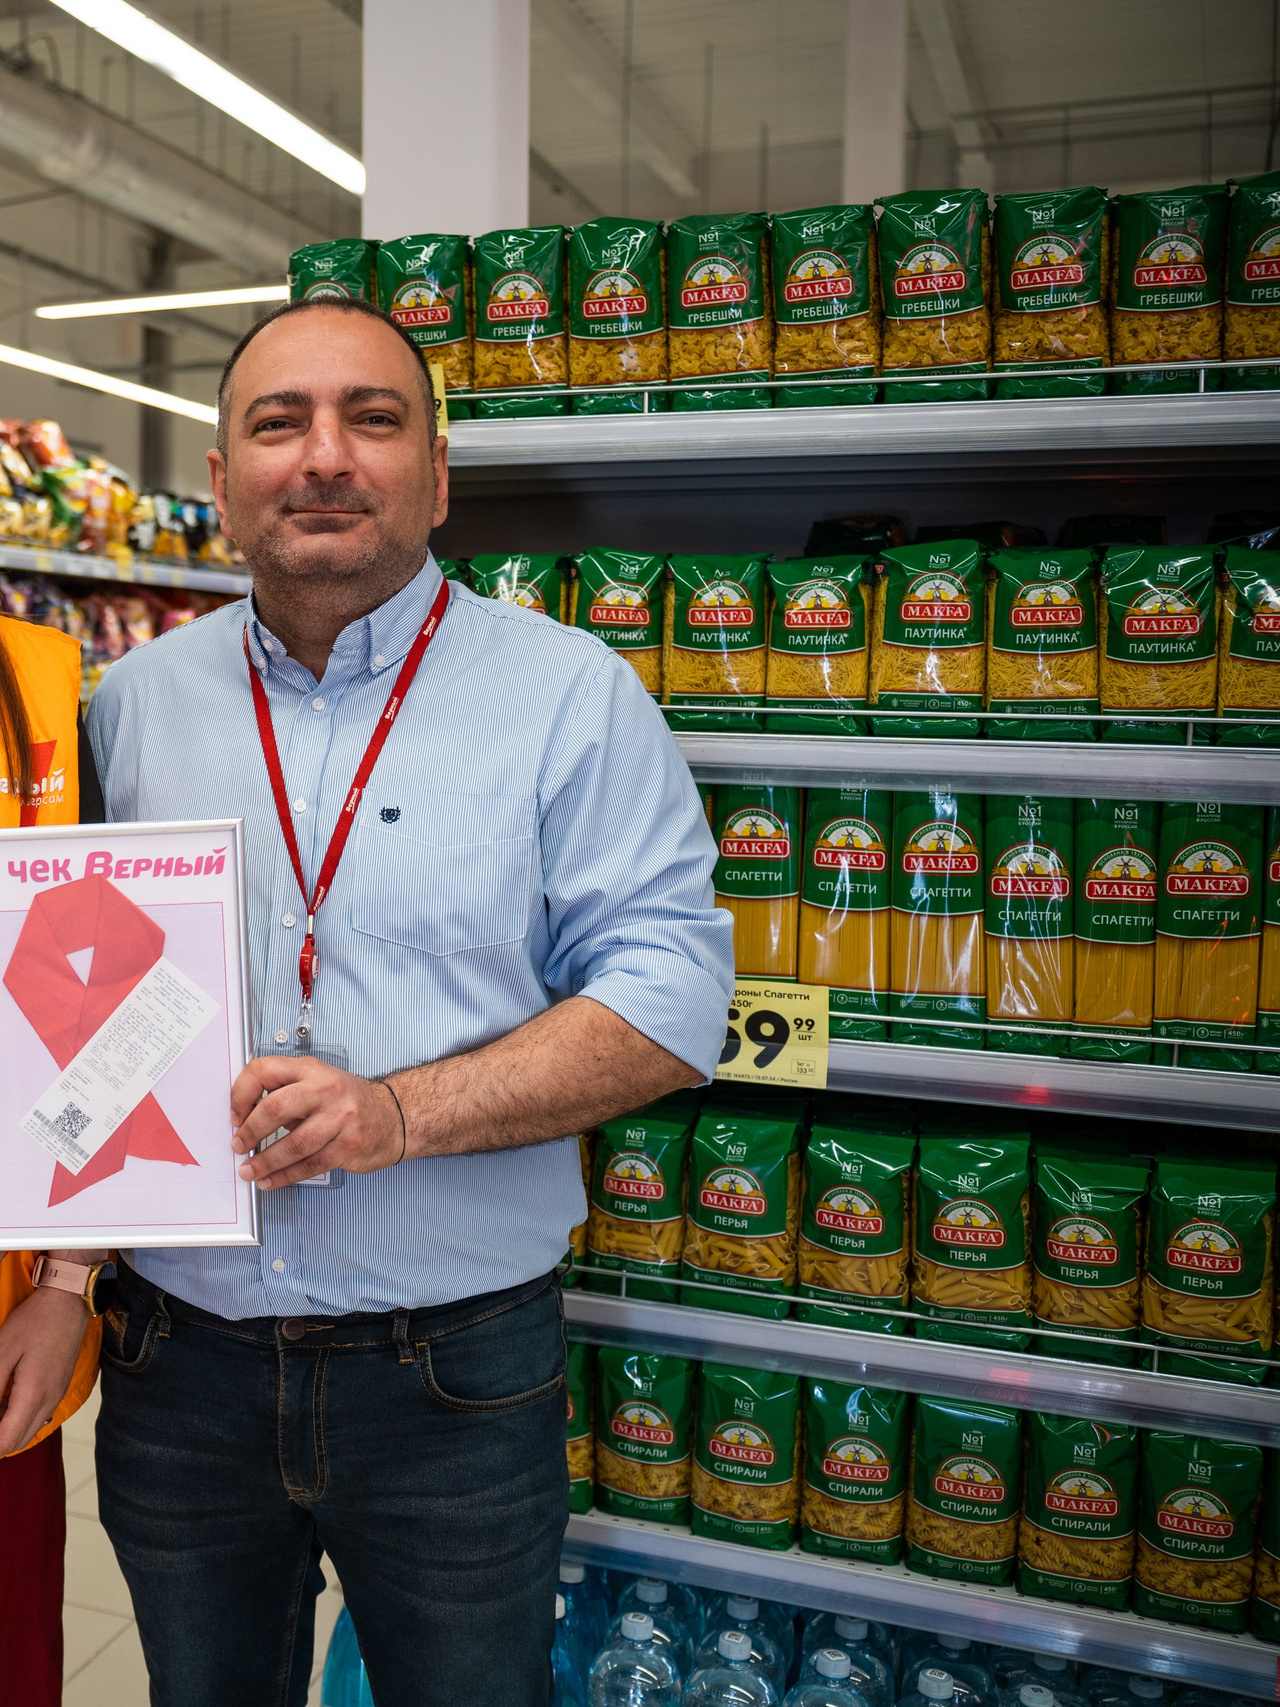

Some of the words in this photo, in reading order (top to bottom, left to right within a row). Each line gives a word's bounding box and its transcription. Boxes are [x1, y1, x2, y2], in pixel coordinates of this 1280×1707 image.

[1016, 270, 1076, 285] MAKFA
[1140, 268, 1202, 283] MAKFA
[790, 283, 845, 298] MAKFA
[900, 276, 958, 292] MAKFA
[687, 286, 740, 301] MAKFA
[1018, 292, 1078, 308] ГРЕБЕШКИ
[1140, 291, 1203, 306] ГРЕБЕШКИ
[492, 304, 542, 316] MAKFA
[588, 300, 640, 314] MAKFA
[792, 304, 848, 318] ГРЕБЕШКИ
[902, 298, 960, 314] ГРЕБЕШКИ
[396, 309, 445, 323] MAKFA
[688, 308, 742, 324] ГРЕБЕШКИ
[493, 325, 544, 338] ГРЕБЕШКИ
[590, 321, 642, 334] ГРЕБЕШКИ
[410, 330, 447, 341] БЕШКИ
[596, 608, 644, 621] MAKFA
[694, 610, 748, 622] MAKFA
[908, 604, 965, 617] MAKFA
[1018, 610, 1077, 622] MAKFA
[790, 614, 844, 624] MAKFA
[1132, 618, 1194, 632] MAKFA
[593, 630, 646, 642] ПАУТИНКА
[692, 631, 747, 642] ПАУТИНКА
[788, 635, 846, 646] ПАУТИНКА
[904, 628, 964, 639] ПАУТИНКА
[1016, 632, 1078, 644] ПАУТИНКА
[1129, 642, 1194, 654] ПАУТИНКА
[346, 788, 358, 812] Верный
[1115, 808, 1138, 819] №1
[1196, 802, 1221, 814] №1
[726, 842, 784, 855] MAKFA
[820, 850, 878, 867] MAKFA
[909, 856, 972, 870] MAKFA
[8, 858, 72, 883] чек
[725, 871, 782, 882] СПАГЕТТИ
[818, 880, 877, 894] СПАГЕТТИ
[910, 886, 972, 898] СПАГЕТТИ
[998, 880, 1062, 892] MAKFA
[1093, 884, 1156, 897] MAKFA
[1174, 878, 1240, 892] MAKFA
[314, 886, 324, 912] ерный
[998, 910, 1062, 922] СПАГЕТТИ
[1092, 914, 1154, 926] СПАГЕТТИ
[1173, 909, 1240, 921] СПАГЕТТИ
[764, 990, 810, 1000] Спагетти
[794, 1018, 815, 1031] 99
[607, 1178, 658, 1196] MAKFA
[614, 1200, 647, 1214] ПЕРЬЯ
[706, 1194, 760, 1212] MAKFA
[714, 1216, 748, 1229] ПЕРЬЯ
[820, 1213, 876, 1231] MAKFA
[830, 1235, 865, 1249] ПЕРЬЯ
[940, 1228, 998, 1244] MAKFA
[950, 1250, 986, 1262] ПЕРЬЯ
[1052, 1244, 1111, 1262] MAKFA
[1172, 1252, 1234, 1270] MAKFA
[1060, 1266, 1099, 1280] ПЕРЬЯ
[1182, 1276, 1223, 1290] ПЕРЬЯ
[617, 1424, 669, 1441] MAKFA
[617, 1441, 668, 1458] СПИРАЛИ
[714, 1444, 768, 1462] MAKFA
[1074, 1445, 1096, 1458] №1
[714, 1462, 767, 1480] СПИРАЛИ
[829, 1462, 884, 1479] MAKFA
[828, 1482, 883, 1496] СПИРАЛИ
[941, 1481, 1000, 1499] MAKFA
[940, 1500, 997, 1516] СПИРАЛИ
[1052, 1496, 1112, 1514] MAKFA
[1051, 1516, 1110, 1532] СПИРАЛИ
[1164, 1516, 1226, 1536] MAKFA
[1163, 1536, 1224, 1554] СПИРАЛИ
